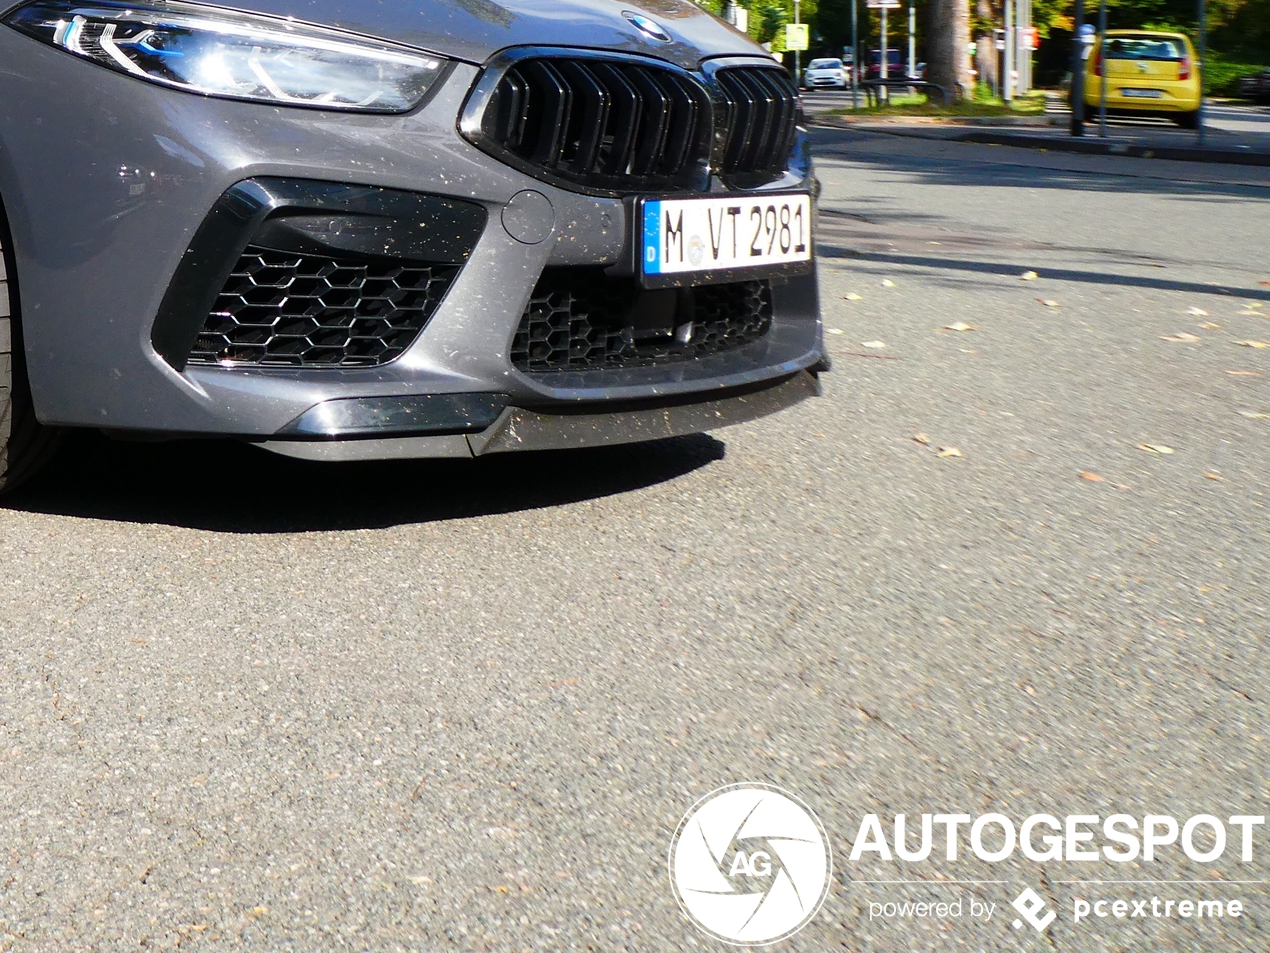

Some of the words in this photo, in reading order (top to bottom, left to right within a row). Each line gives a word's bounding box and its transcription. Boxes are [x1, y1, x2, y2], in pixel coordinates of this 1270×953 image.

[665, 209, 684, 264] M
[708, 206, 741, 260] VT
[750, 203, 806, 257] 2981
[646, 246, 656, 262] D
